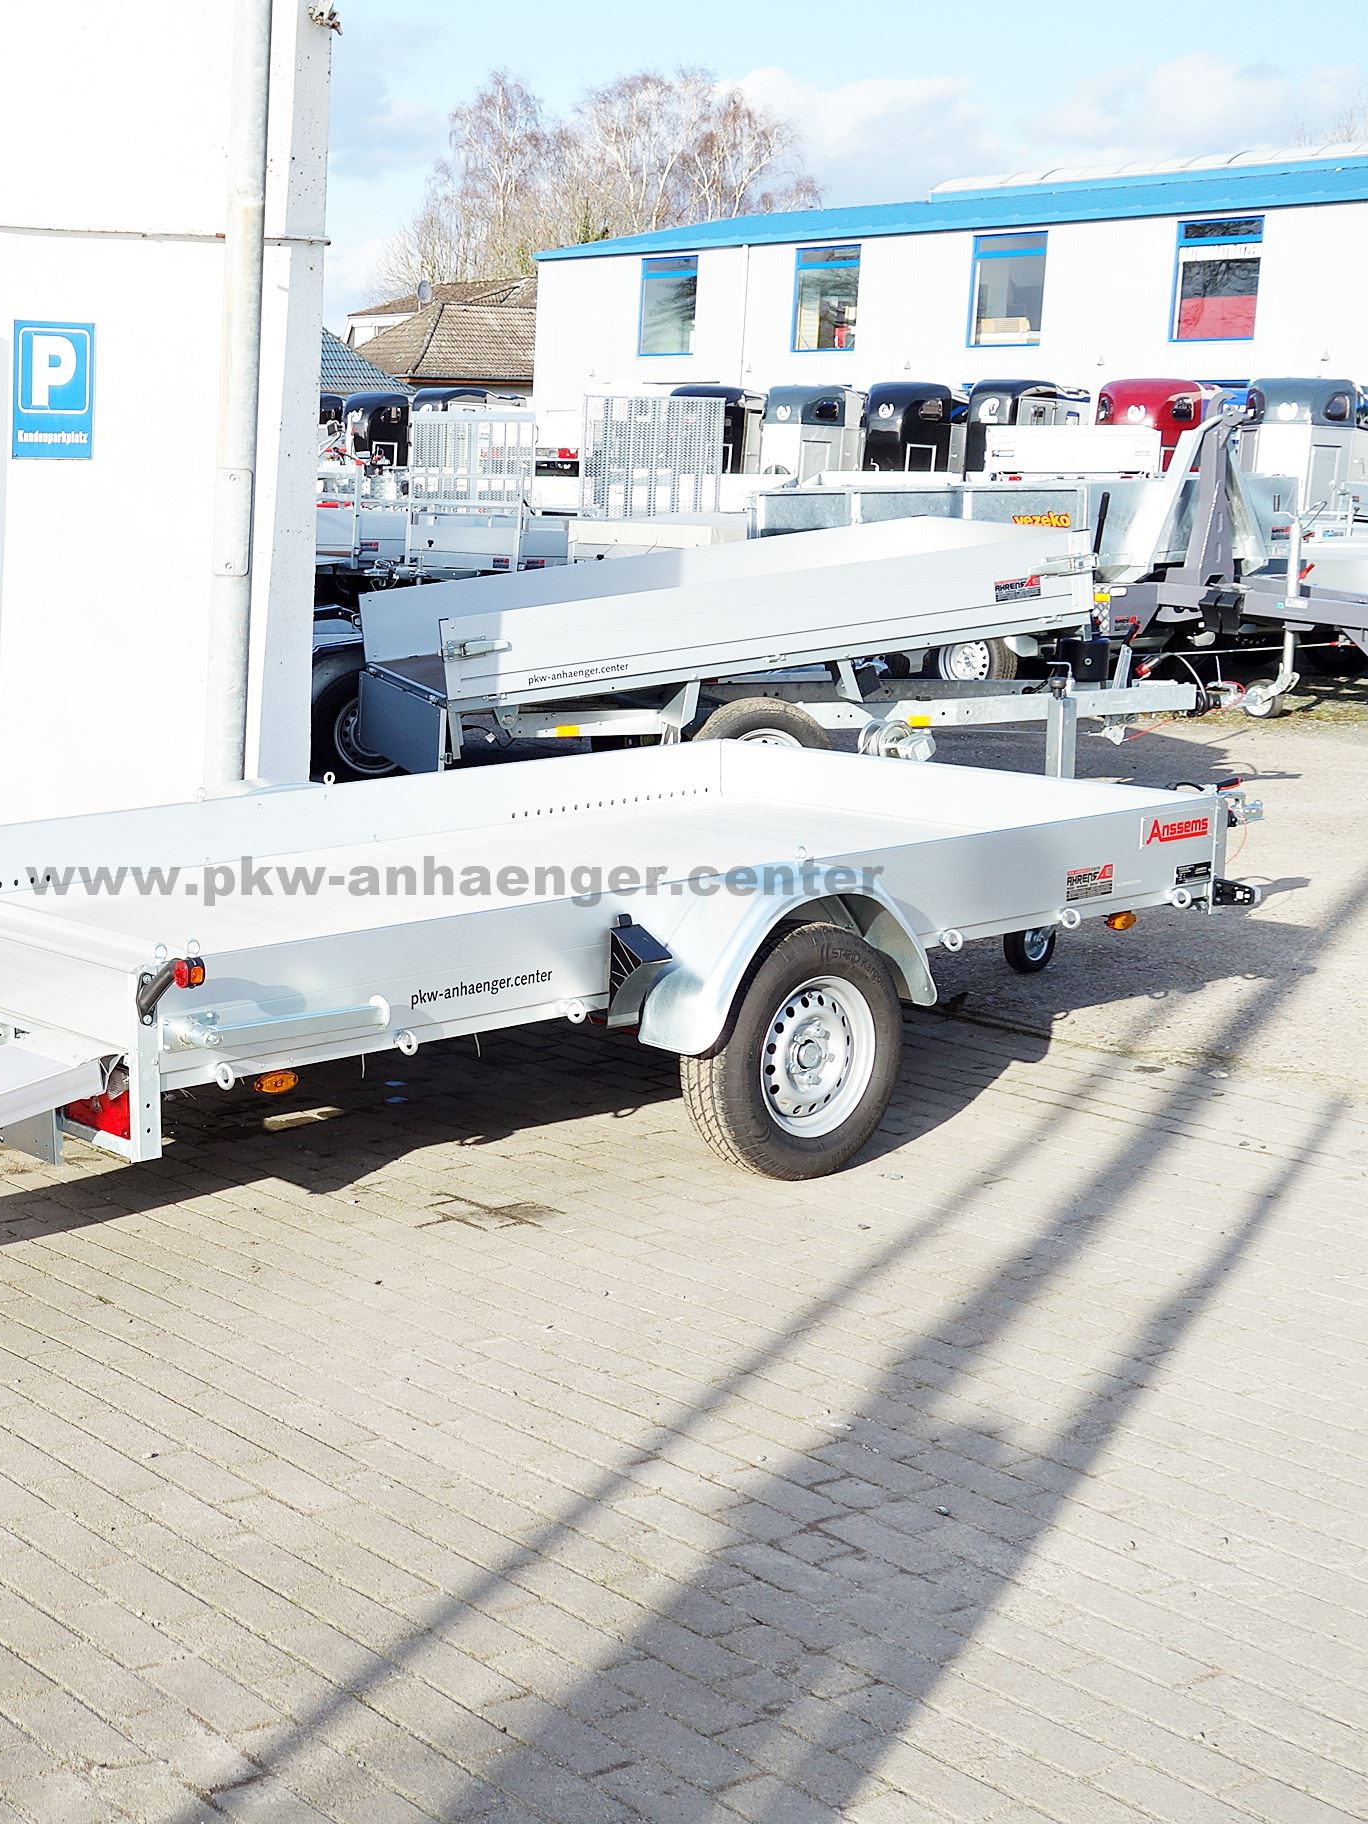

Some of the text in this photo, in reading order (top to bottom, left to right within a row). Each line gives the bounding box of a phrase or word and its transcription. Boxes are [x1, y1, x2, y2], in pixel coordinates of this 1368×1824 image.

[31, 335, 77, 407] P
[1012, 511, 1072, 528] vezeko
[528, 663, 629, 686] pkw-anhaenger.center
[1145, 818, 1209, 845] Anssems
[410, 969, 553, 1010] pkw-anhaenger.center
